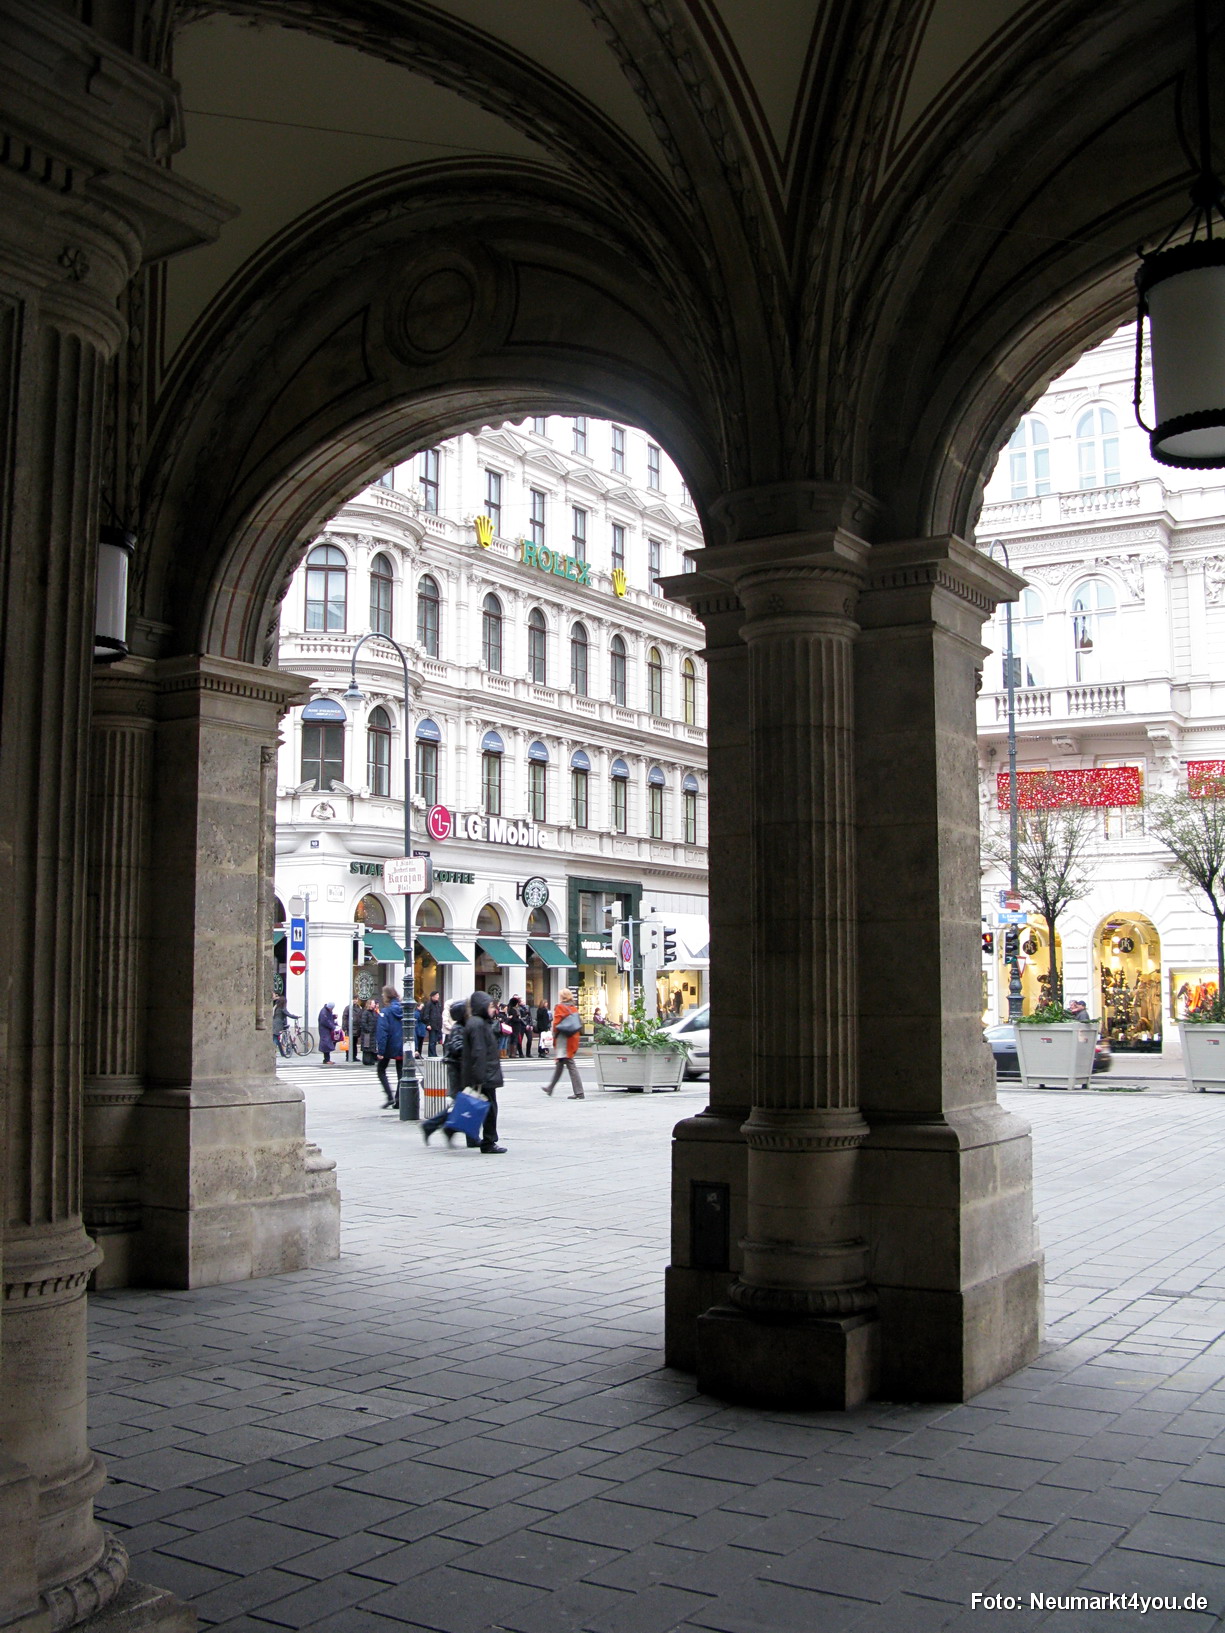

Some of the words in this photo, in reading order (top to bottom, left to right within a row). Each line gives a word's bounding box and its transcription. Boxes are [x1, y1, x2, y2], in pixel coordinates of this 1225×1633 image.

[520, 539, 592, 587] ROLEX
[453, 812, 484, 841] LG
[487, 817, 550, 849] Mobile
[432, 869, 476, 884] COFFEE
